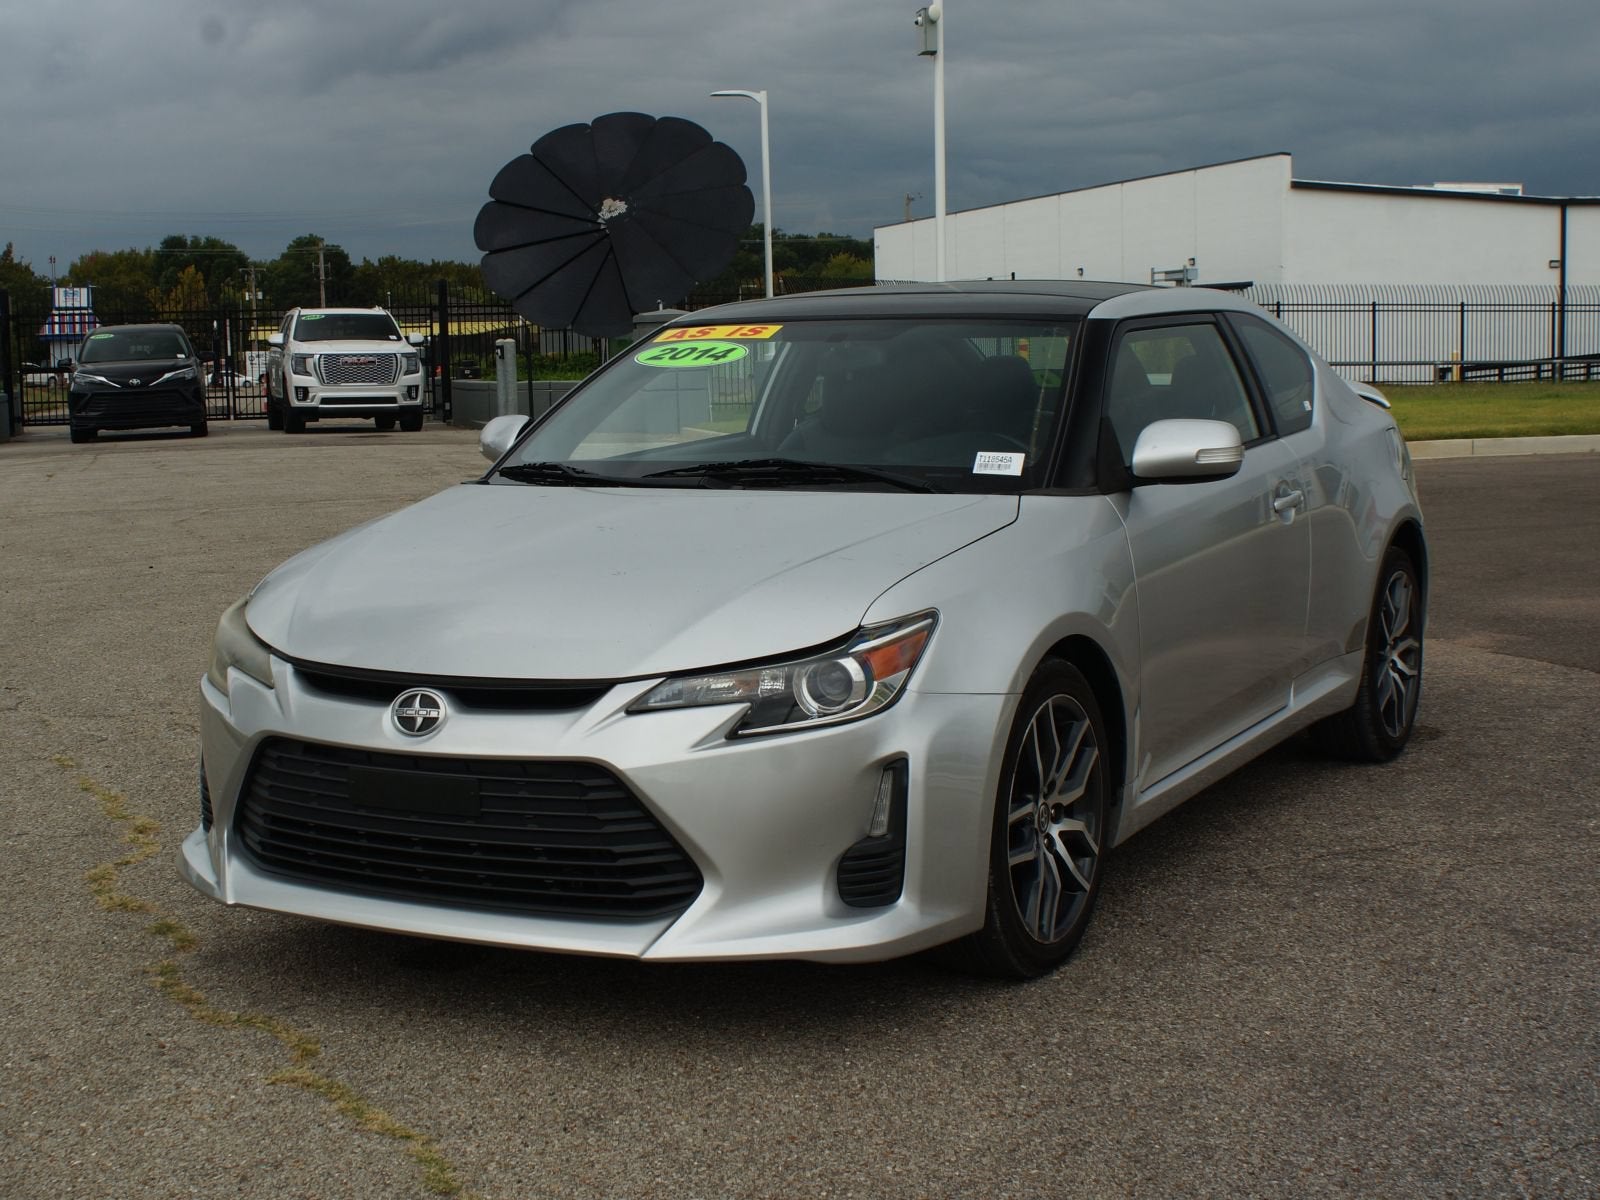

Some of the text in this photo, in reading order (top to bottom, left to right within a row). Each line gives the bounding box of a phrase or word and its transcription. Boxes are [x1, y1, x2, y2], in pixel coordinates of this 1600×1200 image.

[664, 326, 769, 340] AS IS
[645, 346, 740, 361] 2014
